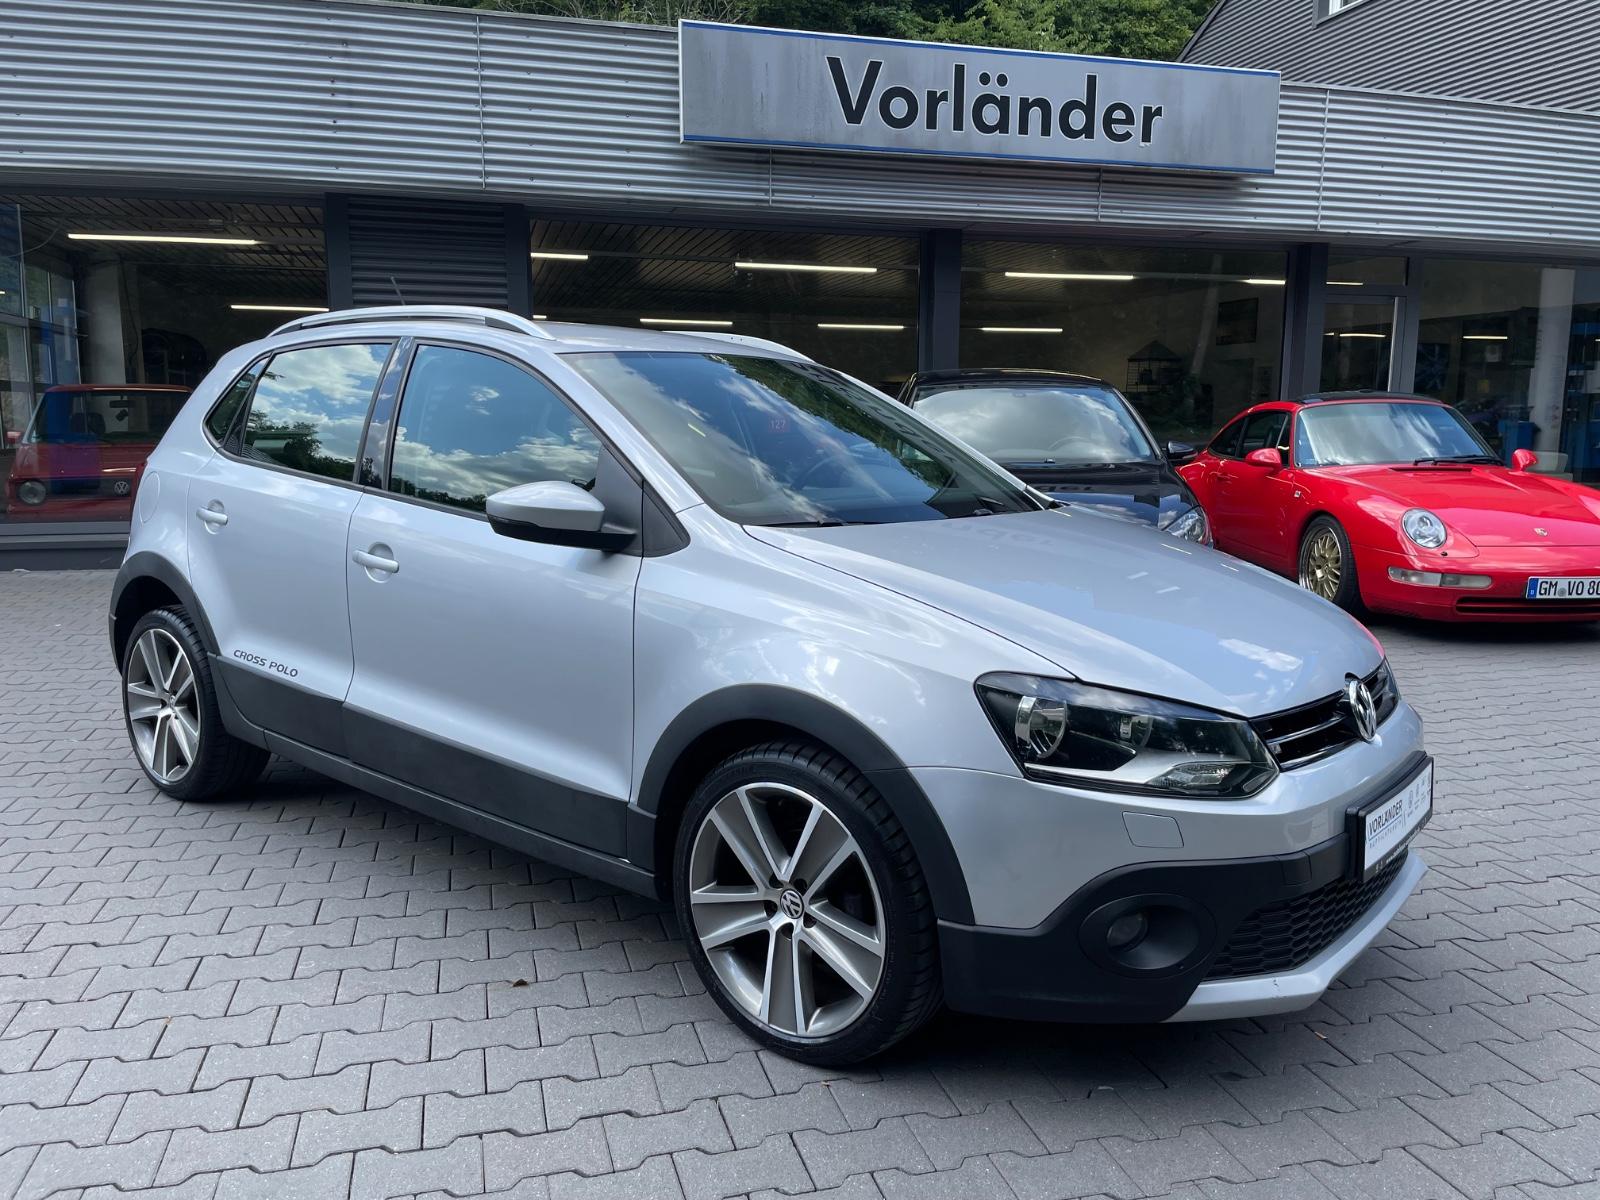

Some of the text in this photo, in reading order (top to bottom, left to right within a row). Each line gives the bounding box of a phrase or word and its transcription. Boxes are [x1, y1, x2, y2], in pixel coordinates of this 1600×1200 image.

[825, 56, 1163, 144] Vorländer
[1538, 580, 1558, 596] GM
[1567, 580, 1585, 596] VO
[233, 649, 298, 677] CROSS POLO
